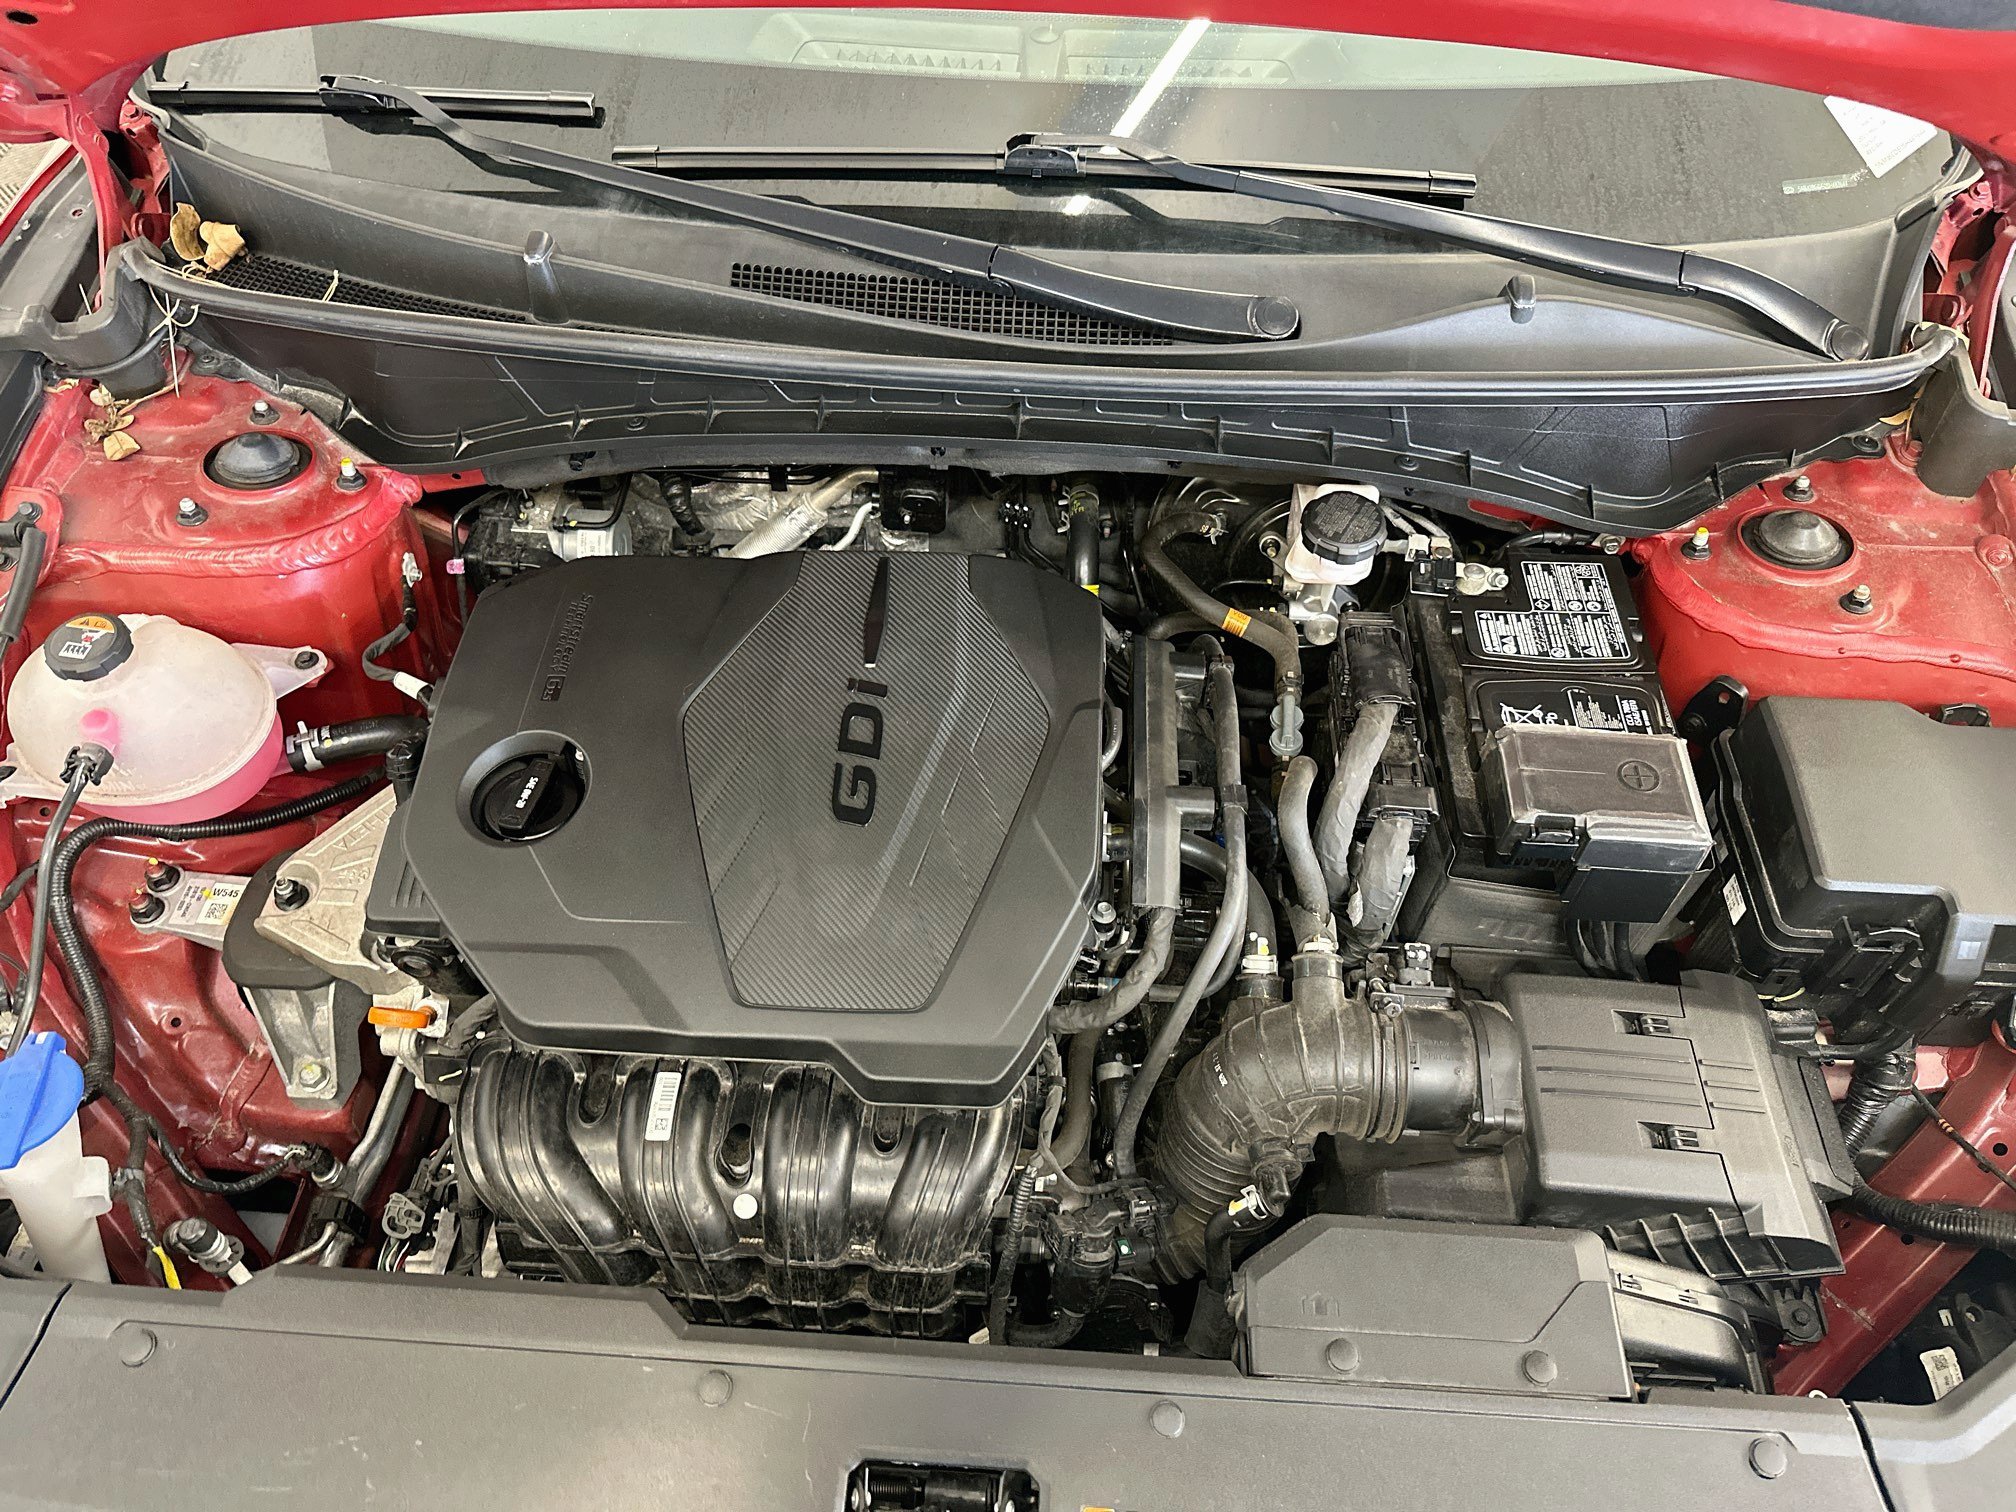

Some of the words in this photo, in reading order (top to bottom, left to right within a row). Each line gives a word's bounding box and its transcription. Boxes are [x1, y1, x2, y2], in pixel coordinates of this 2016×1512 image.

[559, 593, 595, 673] Smartstream
[832, 677, 887, 827] GDi
[213, 888, 240, 898] W545
